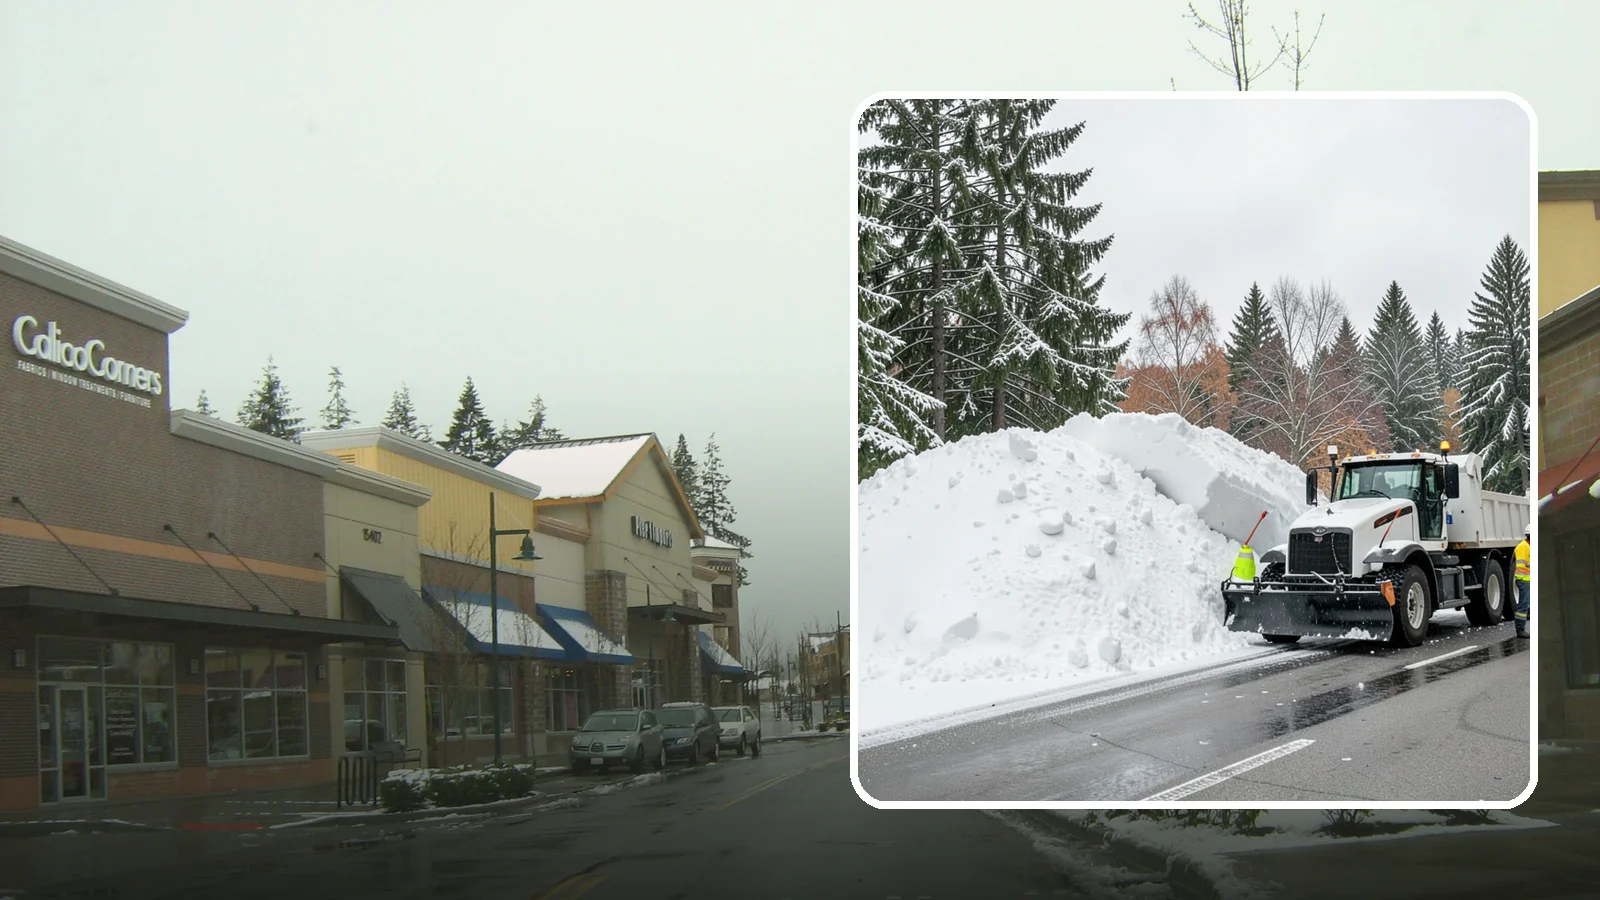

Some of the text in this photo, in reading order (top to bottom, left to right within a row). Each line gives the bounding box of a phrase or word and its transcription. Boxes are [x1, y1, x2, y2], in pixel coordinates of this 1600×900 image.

[17, 360, 151, 409] FABRICS WINDOW TREATMENTS FURNITURE
